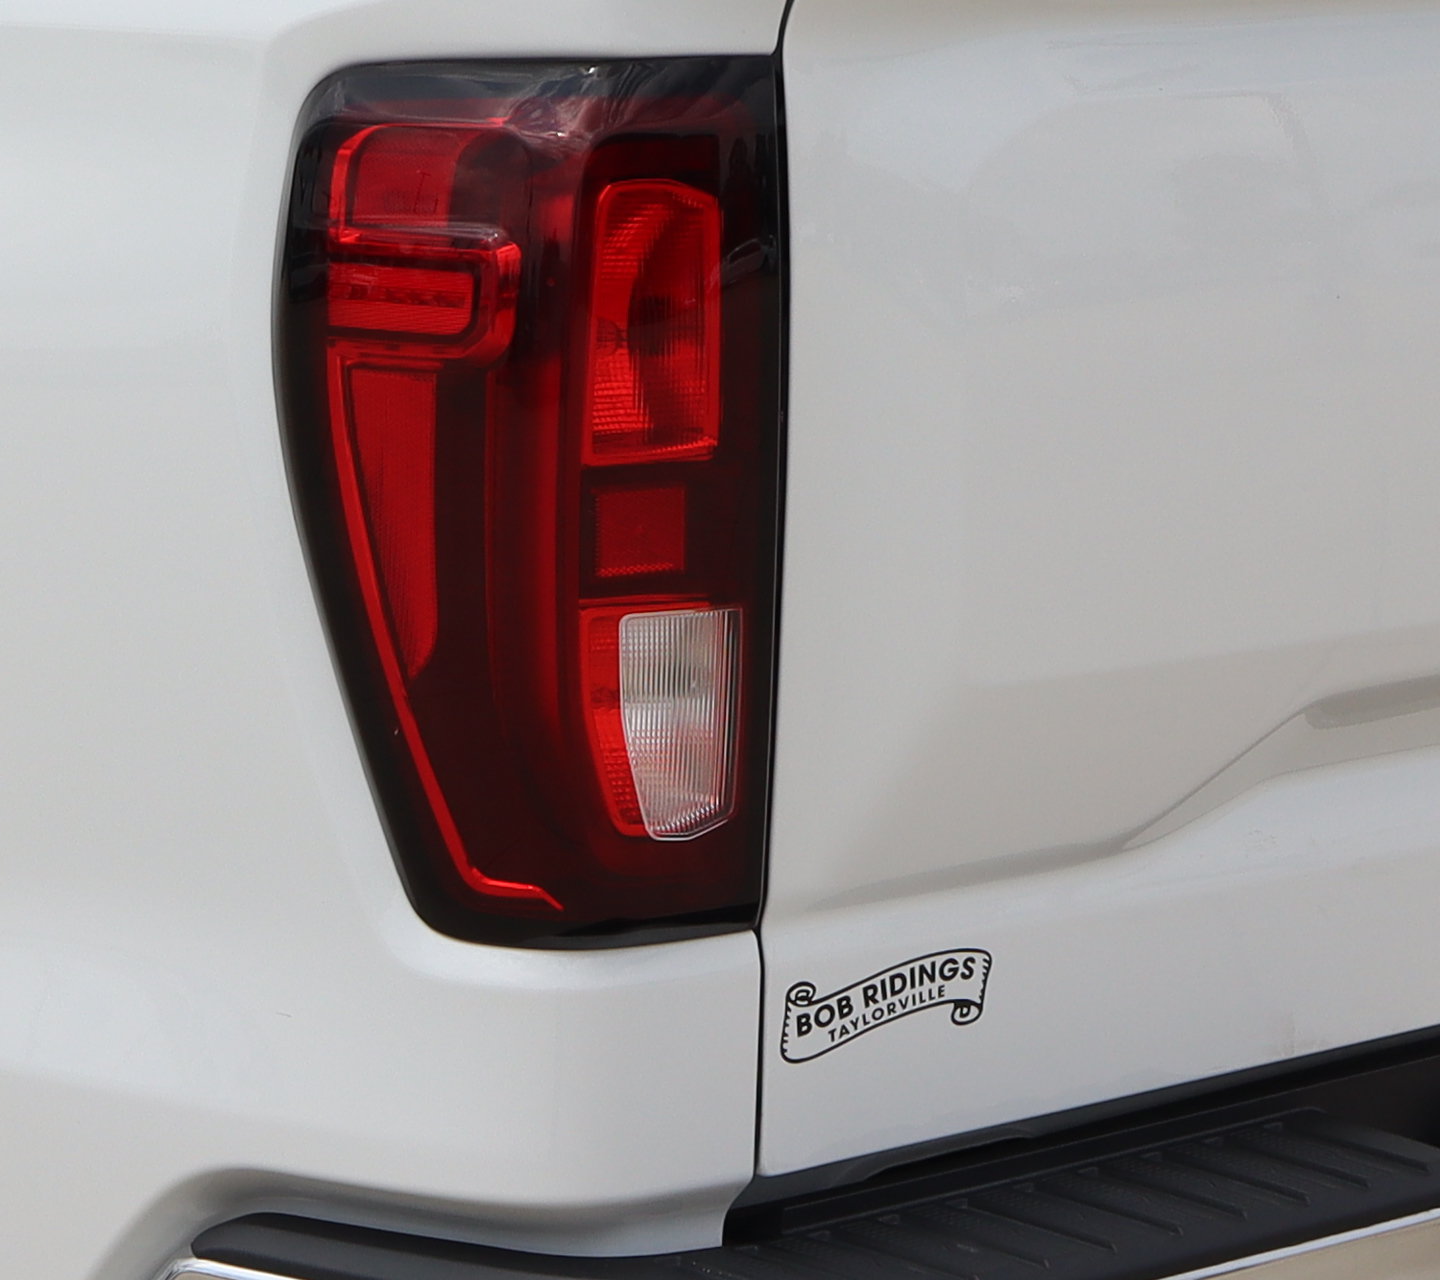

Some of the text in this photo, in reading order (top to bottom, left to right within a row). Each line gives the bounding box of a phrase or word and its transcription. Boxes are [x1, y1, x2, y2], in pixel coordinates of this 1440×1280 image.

[795, 957, 977, 1037] BOB RIDINGS
[827, 985, 946, 1043] TAYLORVILLE
